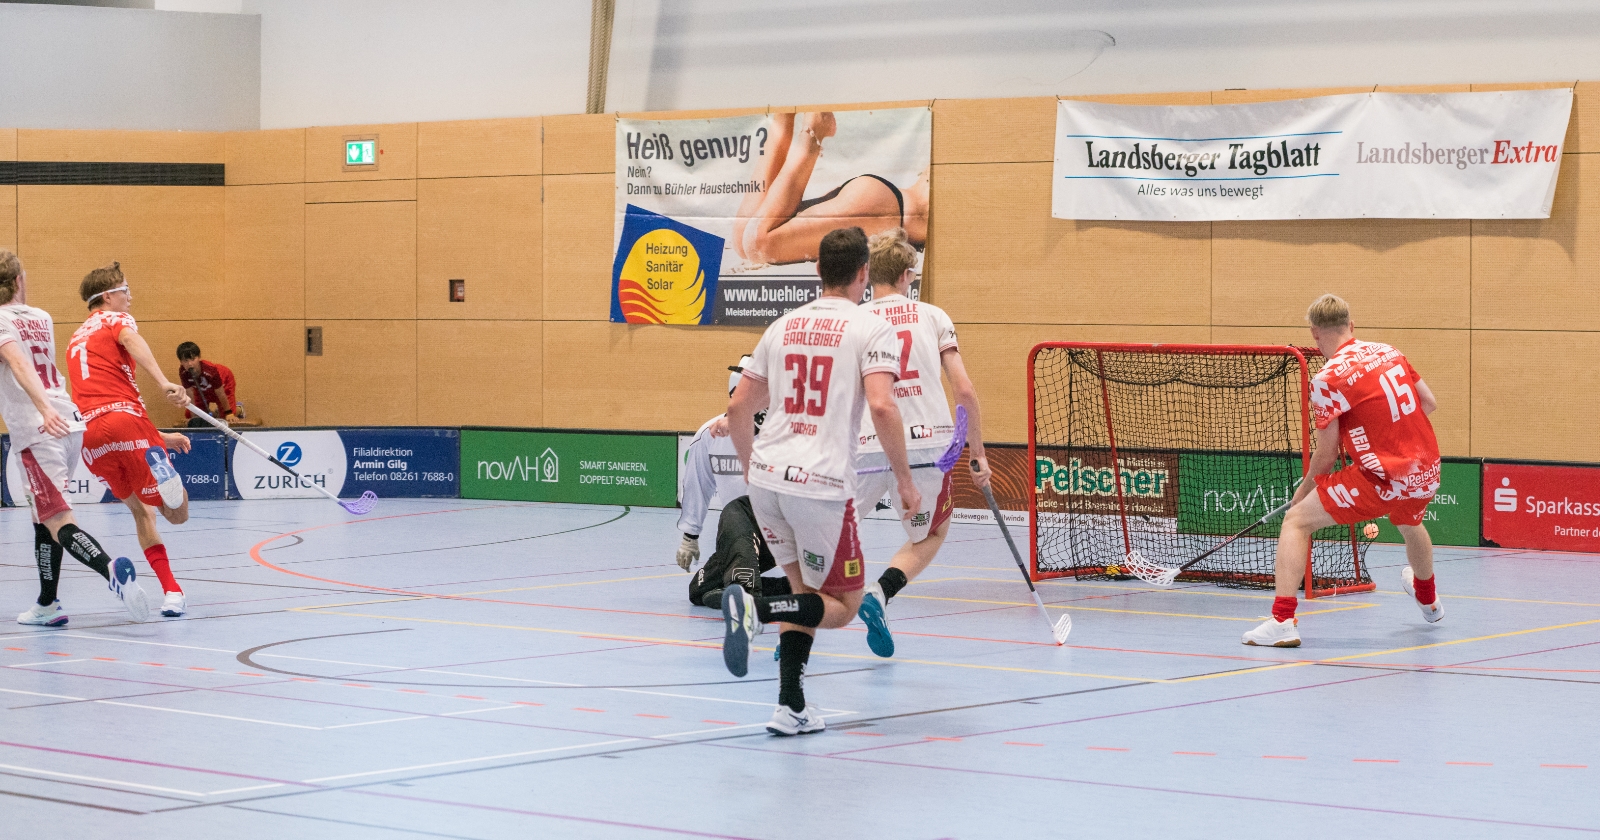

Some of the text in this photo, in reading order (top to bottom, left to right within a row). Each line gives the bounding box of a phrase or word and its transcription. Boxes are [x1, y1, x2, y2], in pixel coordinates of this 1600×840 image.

[627, 132, 673, 160] Heiß
[1086, 140, 1321, 177] Landsberger Tagblatt
[1356, 140, 1558, 170] Landsberger Extra
[627, 166, 652, 178] Nein?
[627, 183, 651, 195] Dann
[653, 186, 662, 195] zu
[665, 183, 697, 195] Bühler
[1137, 184, 1264, 200] Alles was uns bewegt
[645, 243, 688, 257] Heizung
[646, 260, 683, 273] Sanitär
[647, 278, 673, 290] Solar
[725, 307, 778, 317] Meisterbetrieb
[886, 303, 918, 316] HALLE
[785, 317, 849, 333] USV HALLE
[783, 331, 843, 348] SAALEBIBER
[71, 341, 91, 381] 7
[784, 353, 834, 417] 39
[1379, 364, 1416, 423] 15
[353, 447, 413, 457] Filialdirektion
[354, 460, 407, 471] Armin Gilg
[580, 460, 648, 472] SMART SANIEREN.
[1127, 457, 1165, 469] Matthias
[186, 475, 219, 483] 7688-0
[254, 474, 326, 490] ZURICH
[354, 472, 454, 482] Telefon 08261 7688-0
[580, 474, 648, 486] DOPPELT SPAREN.
[1036, 456, 1169, 498] Peischer
[1554, 525, 1590, 537] Partner
